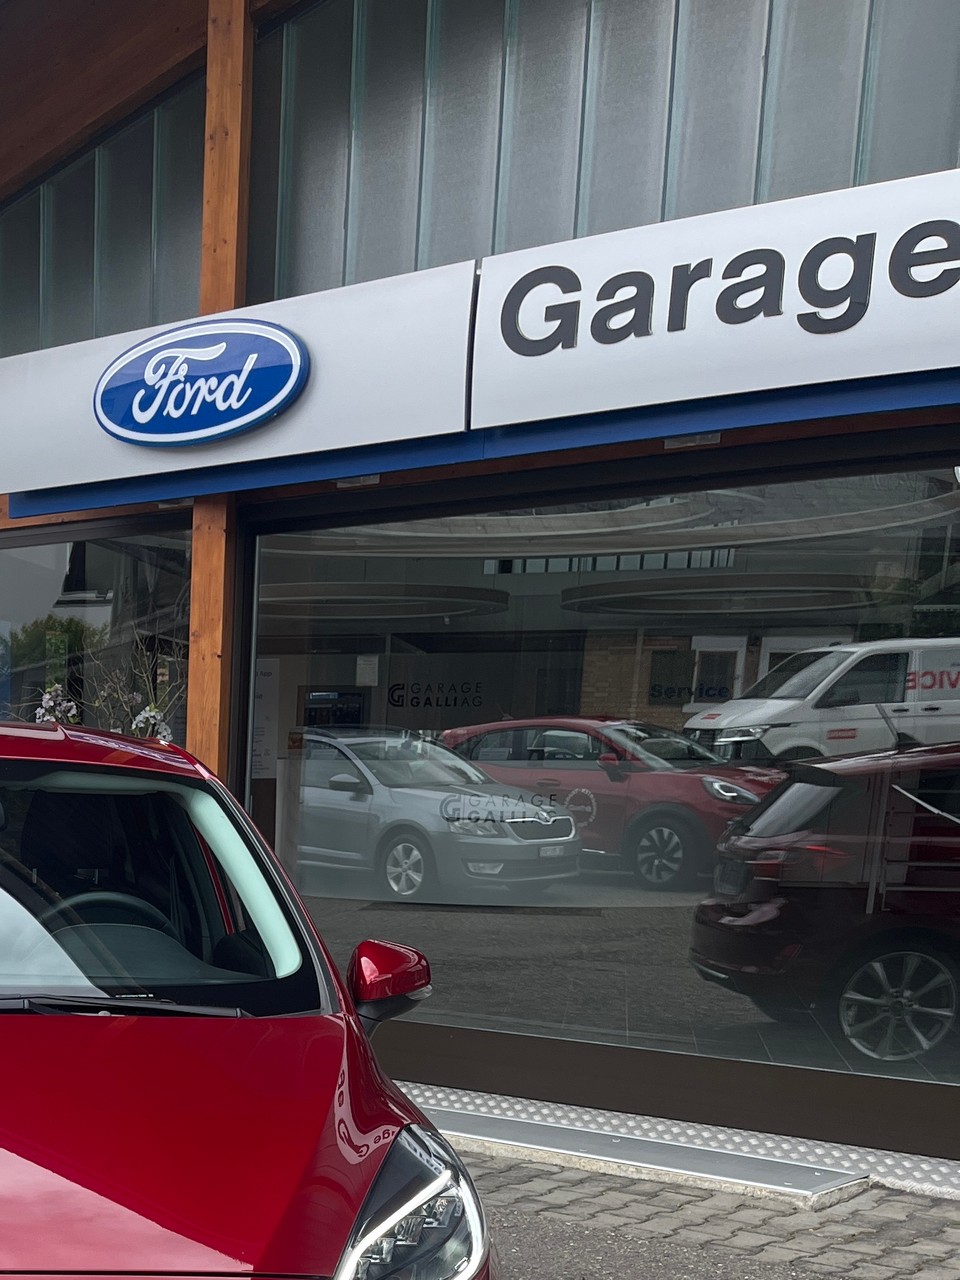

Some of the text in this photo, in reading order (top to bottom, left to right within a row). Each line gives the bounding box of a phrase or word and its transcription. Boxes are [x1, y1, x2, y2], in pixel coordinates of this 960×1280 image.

[500, 218, 960, 357] Garage
[132, 342, 258, 424] Ford
[410, 682, 482, 694] GARAGE
[410, 696, 482, 708] GALLI AG
[468, 793, 557, 808] GARAGE
